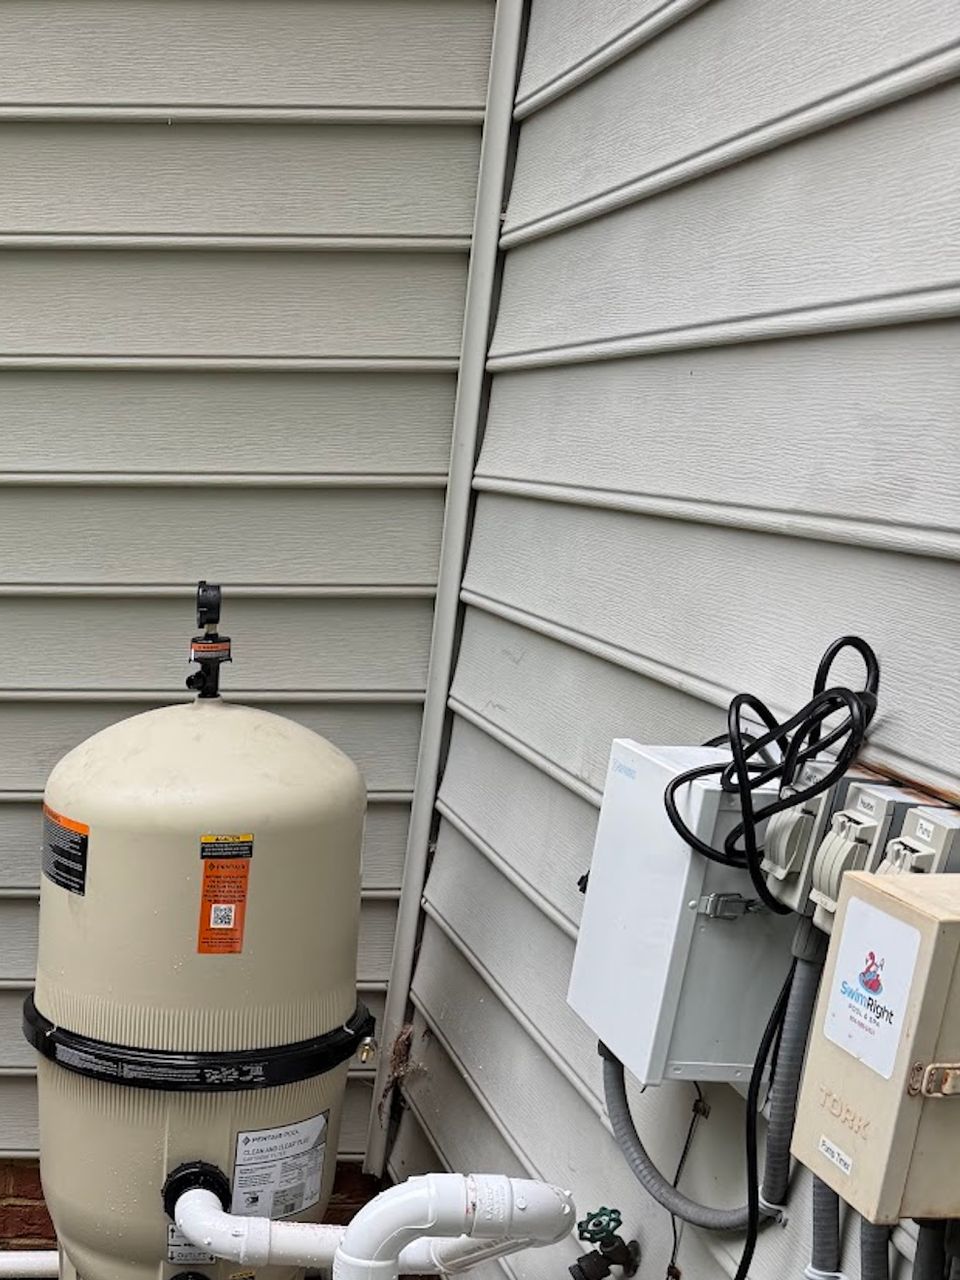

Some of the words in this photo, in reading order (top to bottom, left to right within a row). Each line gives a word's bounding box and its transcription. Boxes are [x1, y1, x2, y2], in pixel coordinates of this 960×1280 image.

[839, 980, 895, 1025] SwimRight
[819, 1085, 871, 1141] TORK
[243, 1148, 264, 1156] CLEAN
